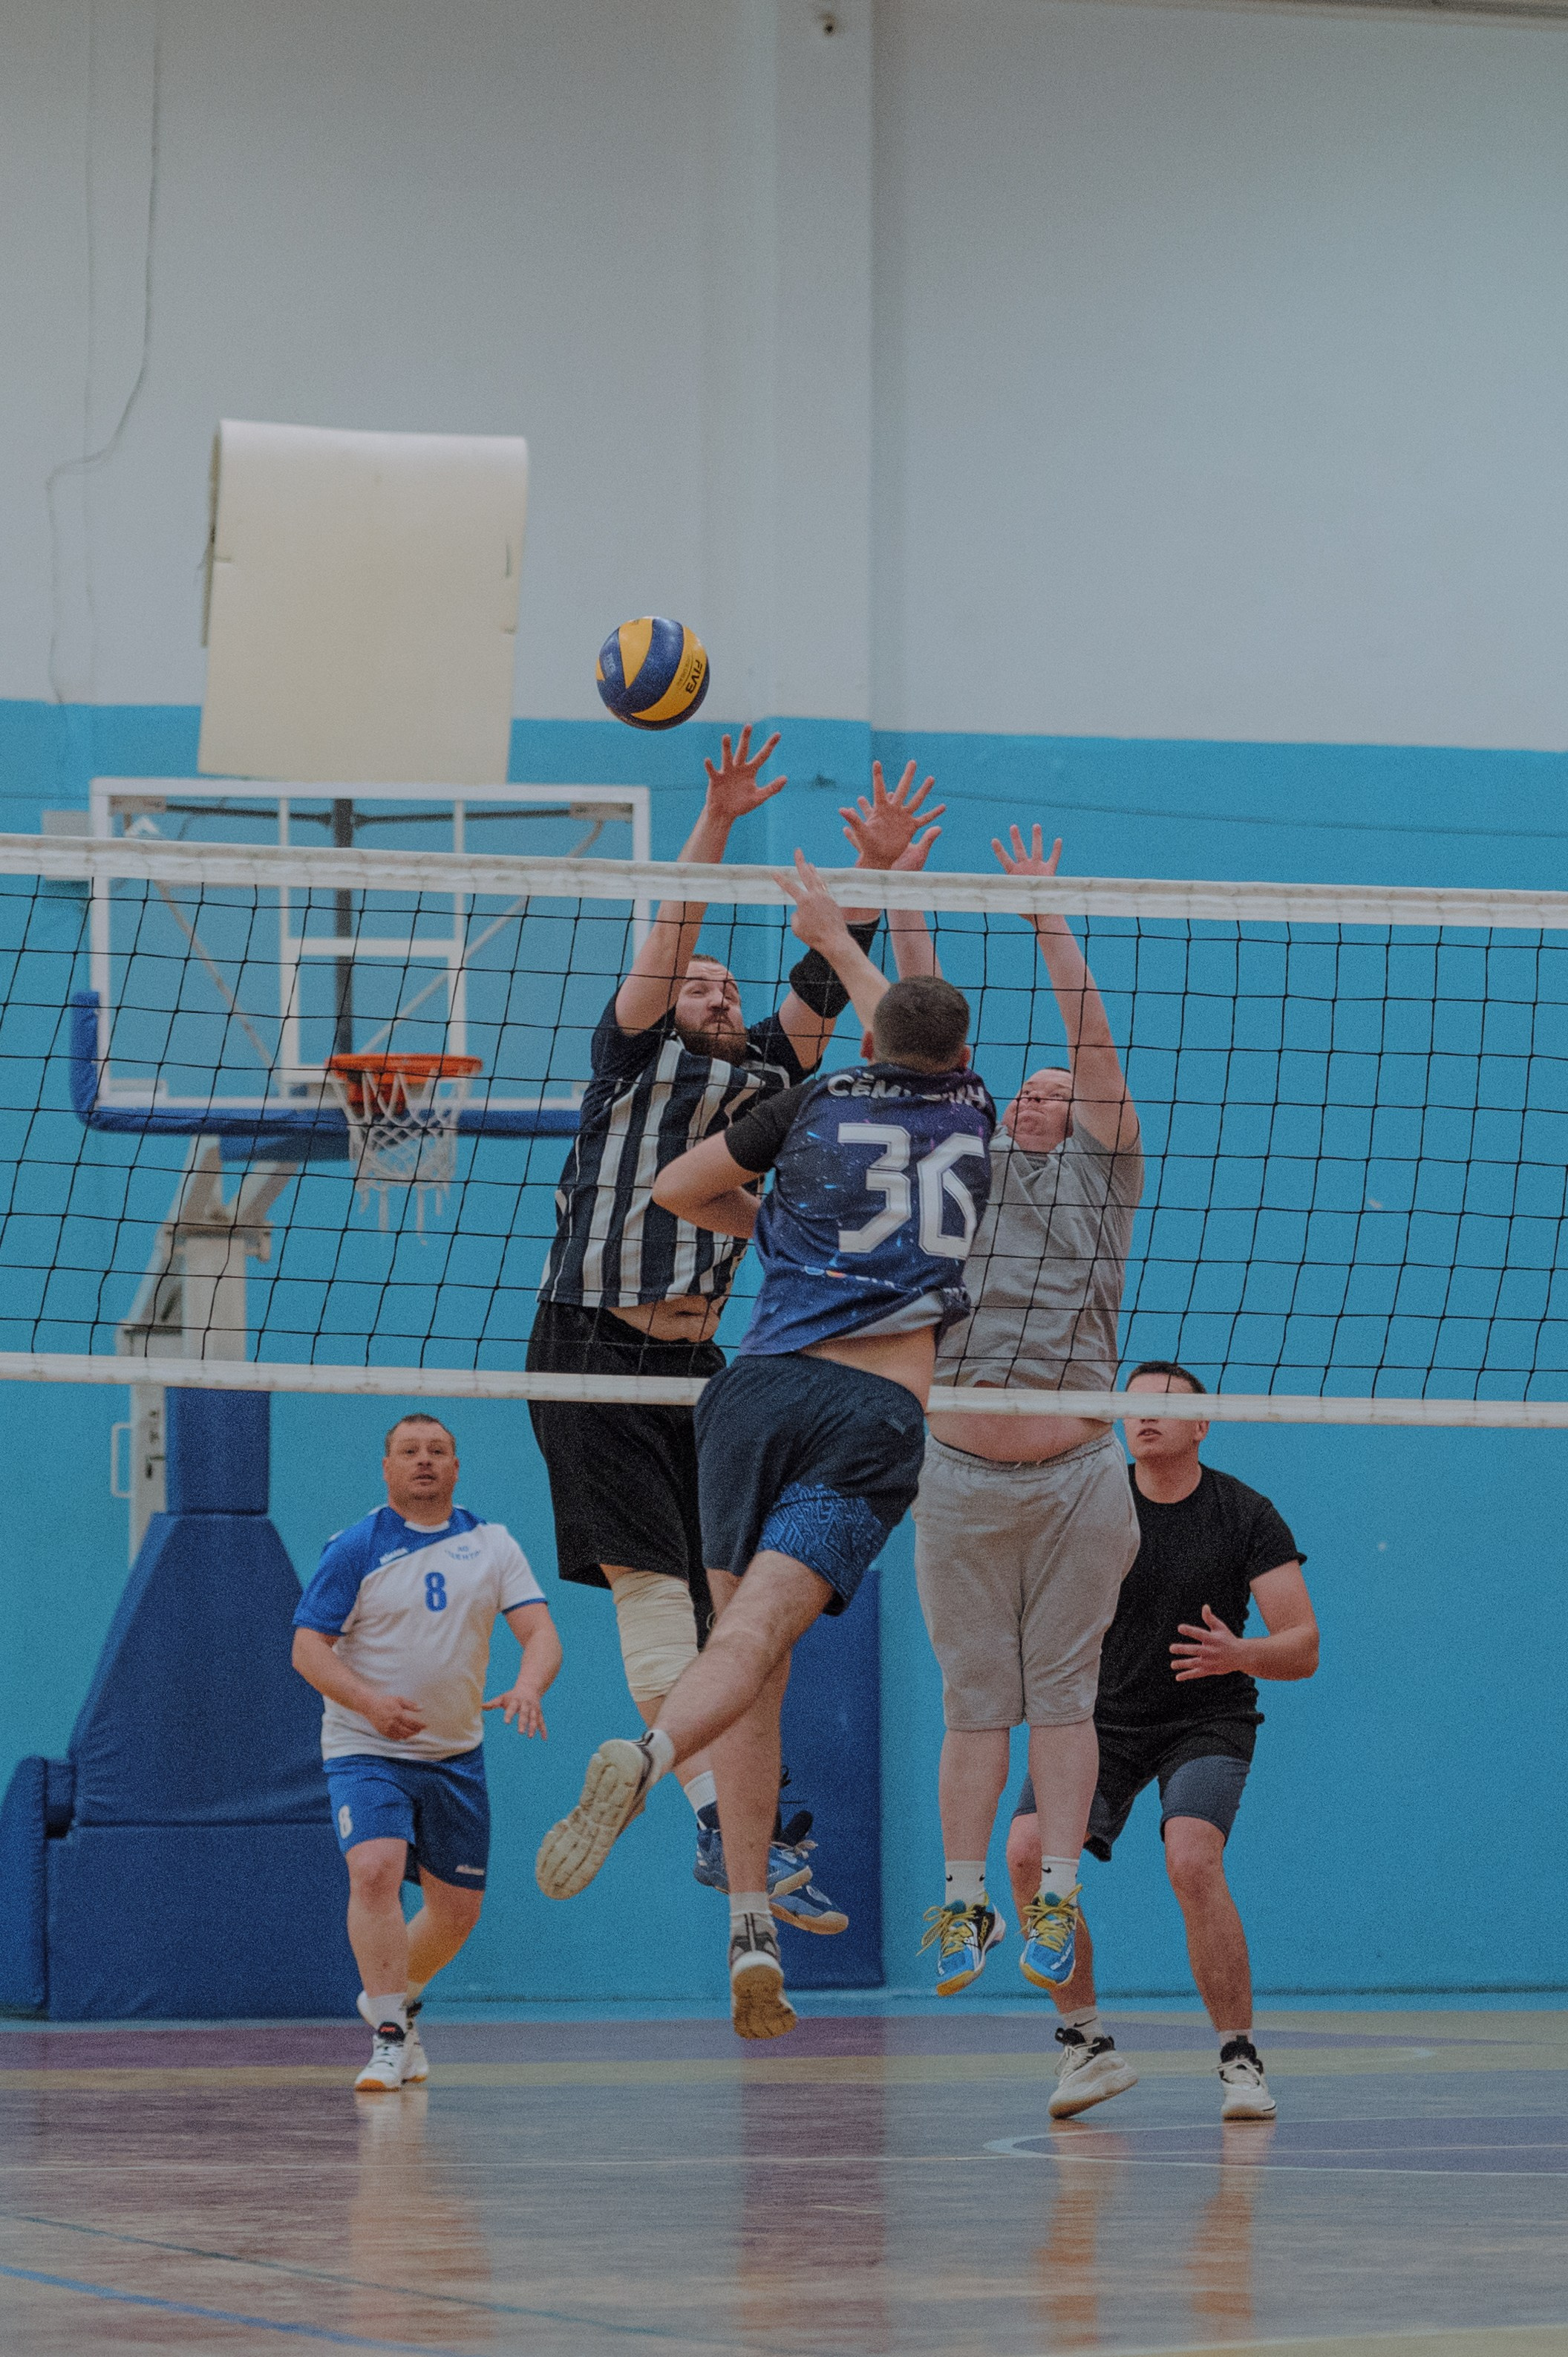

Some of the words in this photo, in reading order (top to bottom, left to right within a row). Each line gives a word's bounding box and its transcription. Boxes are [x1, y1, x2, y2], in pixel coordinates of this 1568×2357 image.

[837, 1122, 985, 1260] 36
[425, 1571, 447, 1612] 8
[338, 1804, 353, 1839] 8
